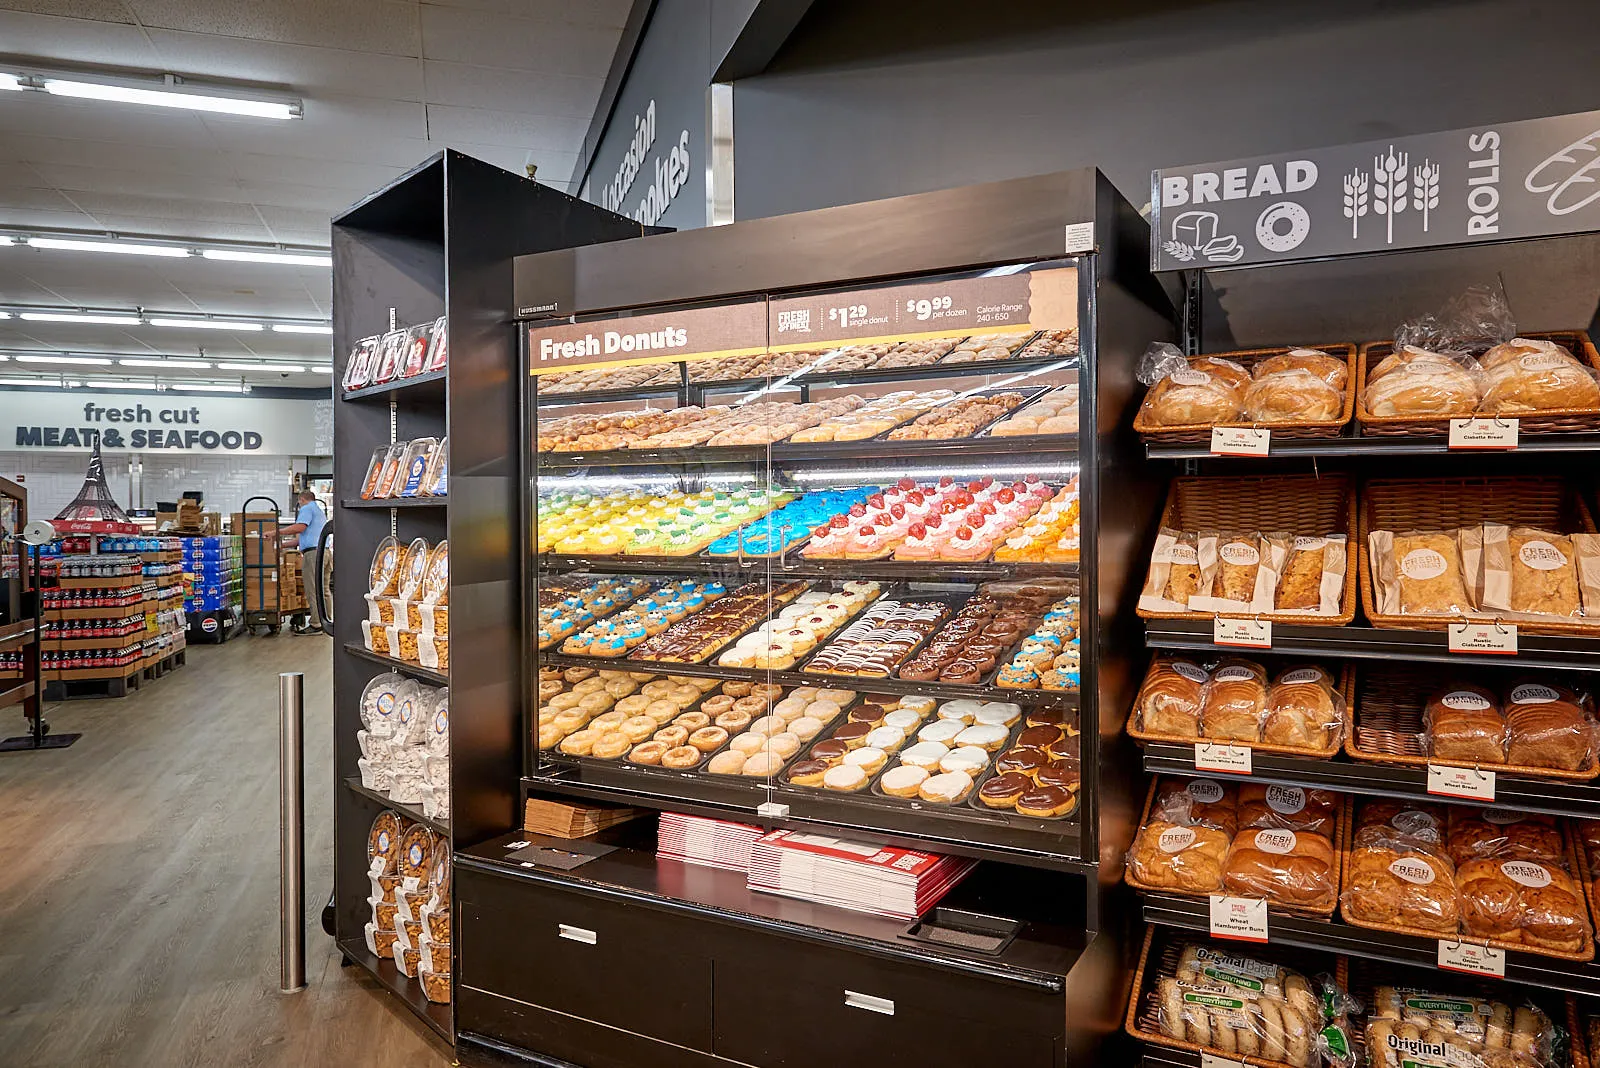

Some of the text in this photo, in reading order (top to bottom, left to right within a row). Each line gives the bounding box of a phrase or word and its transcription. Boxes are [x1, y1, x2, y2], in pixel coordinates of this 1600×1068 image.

[1162, 160, 1319, 208] BREAD
[1467, 130, 1501, 236] ROLLS
[932, 308, 967, 320] per dozen
[976, 303, 1024, 314] Calorie Range
[778, 309, 810, 322] FRESH
[849, 316, 889, 327] single donut
[540, 326, 688, 361] Fresh Donuts
[84, 402, 200, 424] fresh cut
[16, 426, 263, 450] MEAT & SEAFOOD
[1189, 784, 1219, 793] FRESH
[1269, 785, 1302, 799] FRESH
[1162, 833, 1192, 841] FRESH
[1259, 832, 1293, 844] FRESH
[1392, 864, 1430, 876] FRESH
[1503, 865, 1543, 876] FRESH
[1214, 922, 1248, 931] Hamburger
[1197, 949, 1246, 969] Original
[1214, 970, 1252, 988] EVERYTHING
[1195, 996, 1233, 1007] EVERYTHING
[1419, 1001, 1462, 1011] EVERYTHING
[1387, 1034, 1446, 1057] Original
